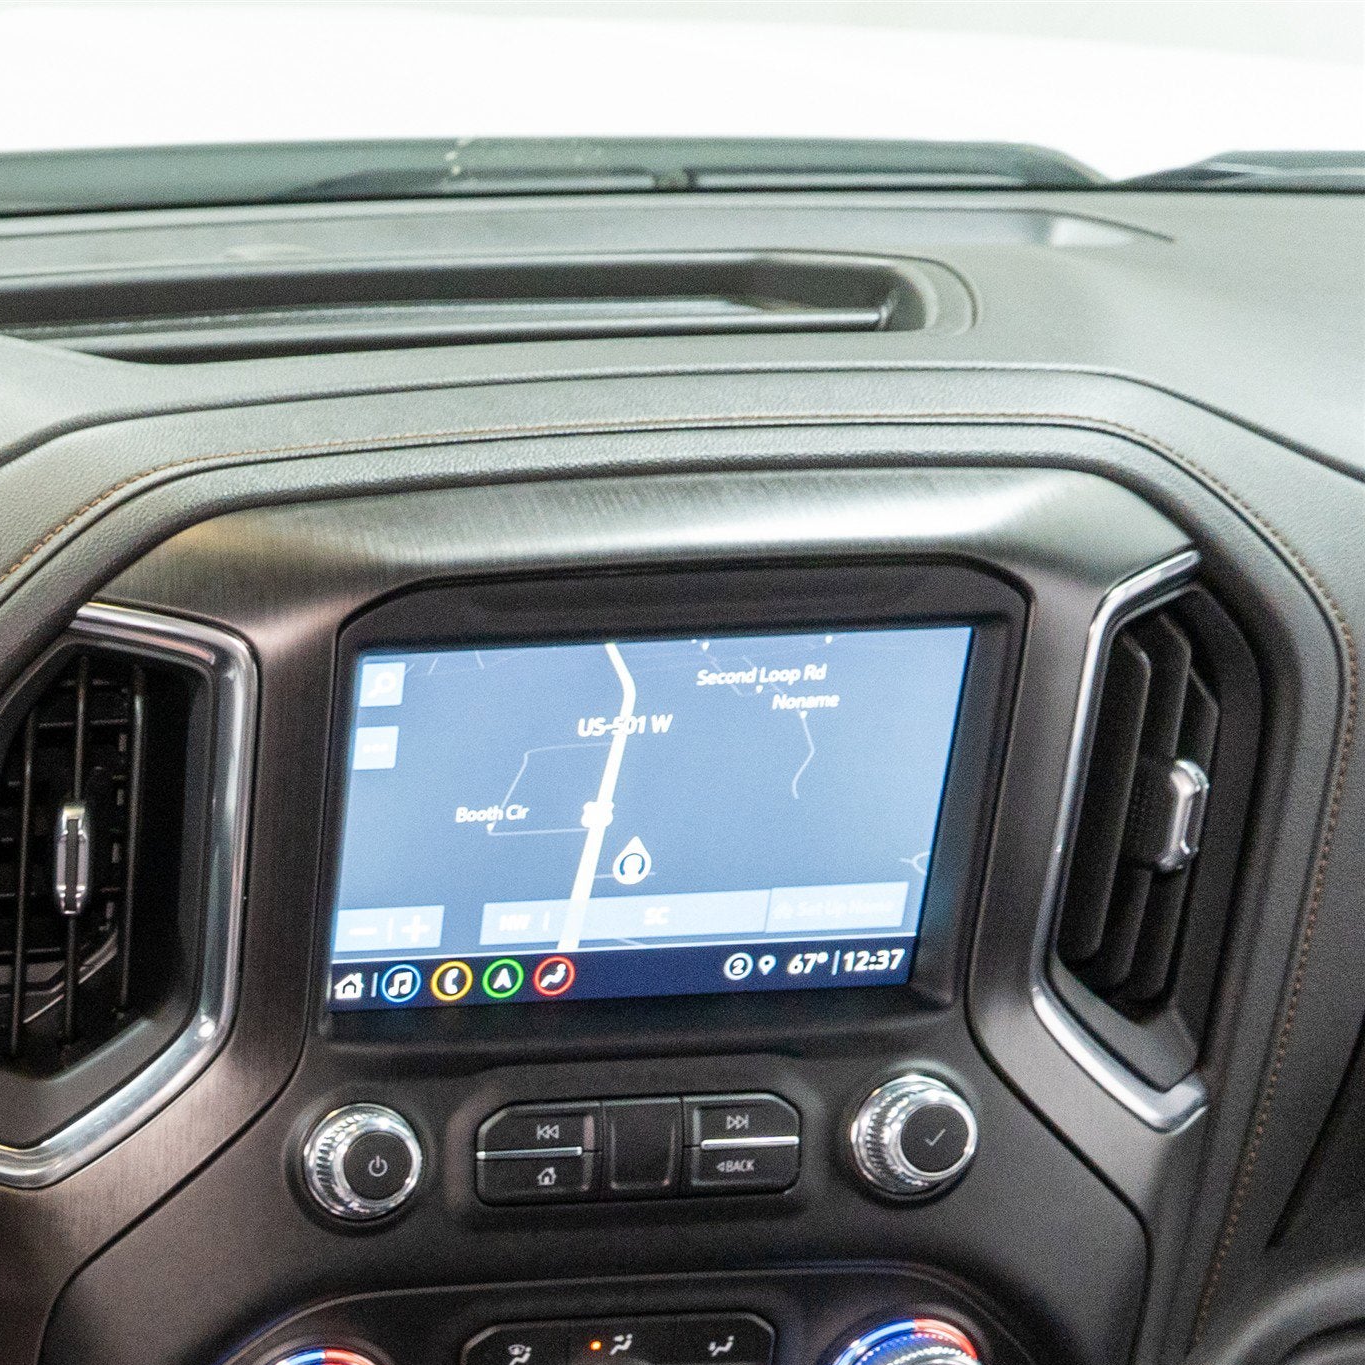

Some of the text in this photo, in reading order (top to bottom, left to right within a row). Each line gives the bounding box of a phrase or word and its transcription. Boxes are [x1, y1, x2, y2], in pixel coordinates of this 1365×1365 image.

[696, 663, 828, 686] Second Loop Rd
[772, 694, 840, 710] Noname
[577, 714, 673, 737] US-501 W
[455, 808, 504, 823] Booth
[843, 949, 905, 972] 12:37
[725, 1159, 755, 1172] BACK
